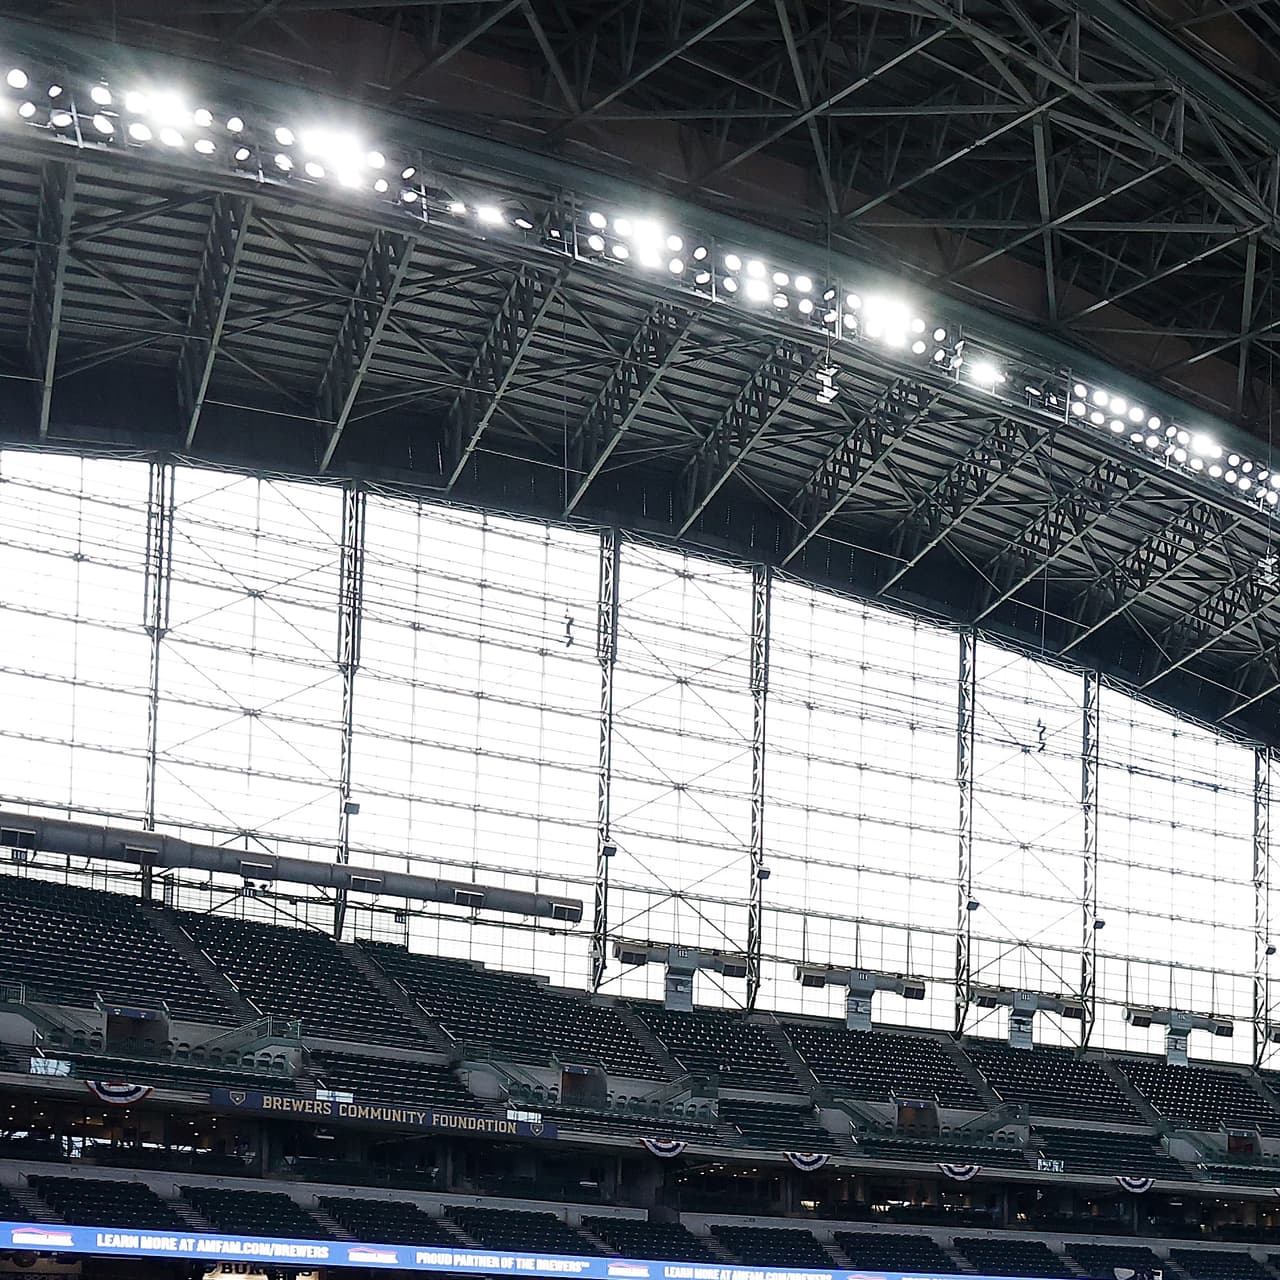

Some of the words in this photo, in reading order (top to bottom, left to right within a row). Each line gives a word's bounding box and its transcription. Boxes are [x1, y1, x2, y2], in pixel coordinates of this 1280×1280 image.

[262, 1096, 331, 1115] BREWERS
[338, 1104, 426, 1125] COMMUNITY
[432, 1113, 517, 1134] FOUNDATION
[96, 1233, 140, 1249] LEARN
[140, 1236, 178, 1251] MORE
[178, 1238, 194, 1252] AT
[416, 1252, 452, 1266] PROUD
[453, 1254, 500, 1268] PARTNER
[500, 1256, 515, 1269] OF
[516, 1257, 536, 1270] THE
